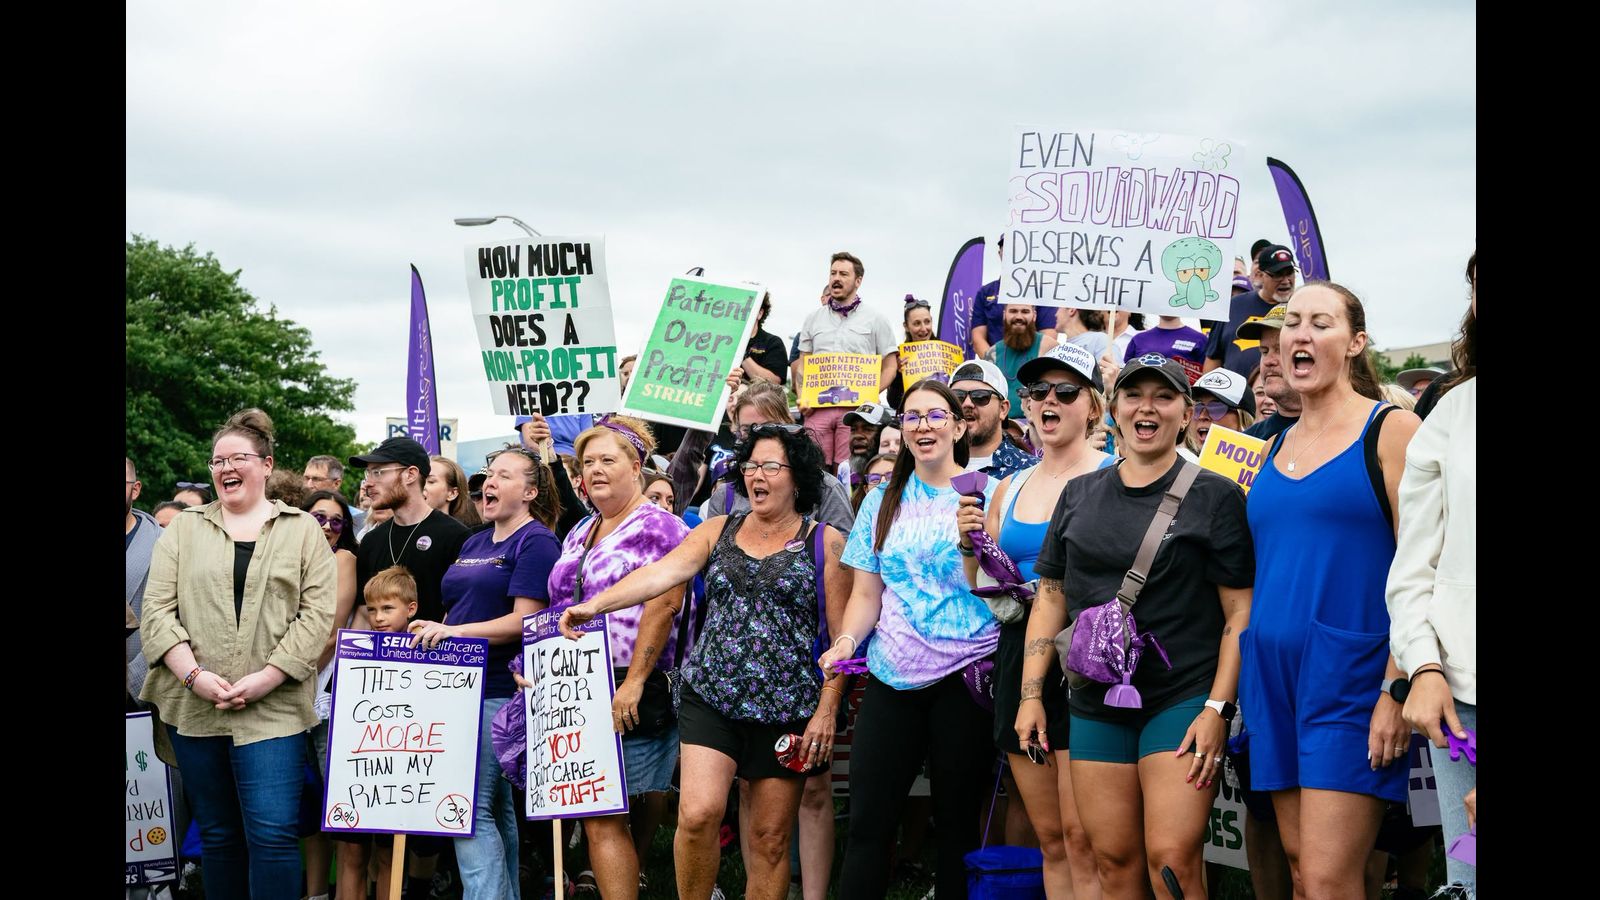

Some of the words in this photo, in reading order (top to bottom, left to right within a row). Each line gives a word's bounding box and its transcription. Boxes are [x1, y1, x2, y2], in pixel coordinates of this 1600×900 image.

[1020, 132, 1095, 168] EVEN
[478, 245, 520, 278] HOW
[528, 242, 593, 277] MUCH
[1012, 230, 1124, 267] DESERVES
[1134, 239, 1154, 274] A
[1299, 218, 1313, 278] Care
[491, 276, 581, 312] PROFIT
[667, 285, 754, 321] Patient
[1006, 267, 1069, 301] SAFE
[1075, 273, 1151, 308] SHIFT
[489, 313, 546, 347] DOES
[563, 313, 579, 345] A
[664, 319, 733, 353] Over
[807, 356, 836, 365] MOUNT
[838, 356, 878, 365] NITTANY
[903, 343, 934, 353] MOUNT
[1057, 344, 1089, 359] Happens
[481, 346, 617, 382] NON-PROFIT
[643, 349, 723, 393] Profit
[819, 364, 863, 373] WORKERS:
[905, 367, 920, 376] FOR
[506, 380, 590, 416] NEED??
[642, 383, 707, 407] STRIKE
[1216, 440, 1262, 470] MOU
[340, 649, 373, 657] Pennsylvania
[381, 648, 412, 659] United
[414, 650, 427, 660] for
[428, 650, 462, 665] Quality
[463, 653, 485, 664] Care
[532, 648, 546, 686] WE
[551, 647, 600, 677] CAN'T
[350, 666, 412, 694] THIS
[424, 670, 477, 690] SIGN
[551, 678, 592, 710] FOR
[352, 699, 414, 723] COSTS
[357, 722, 445, 752] MORE
[533, 738, 547, 770] IF
[548, 731, 581, 763] YOU
[347, 756, 393, 777] THAN
[406, 754, 433, 776] MY
[552, 760, 595, 783] CARE
[349, 783, 435, 808] RAISE
[530, 789, 546, 813] FOR
[549, 776, 605, 806] STAFF
[333, 807, 355, 822] 2%
[444, 803, 468, 822] 3%
